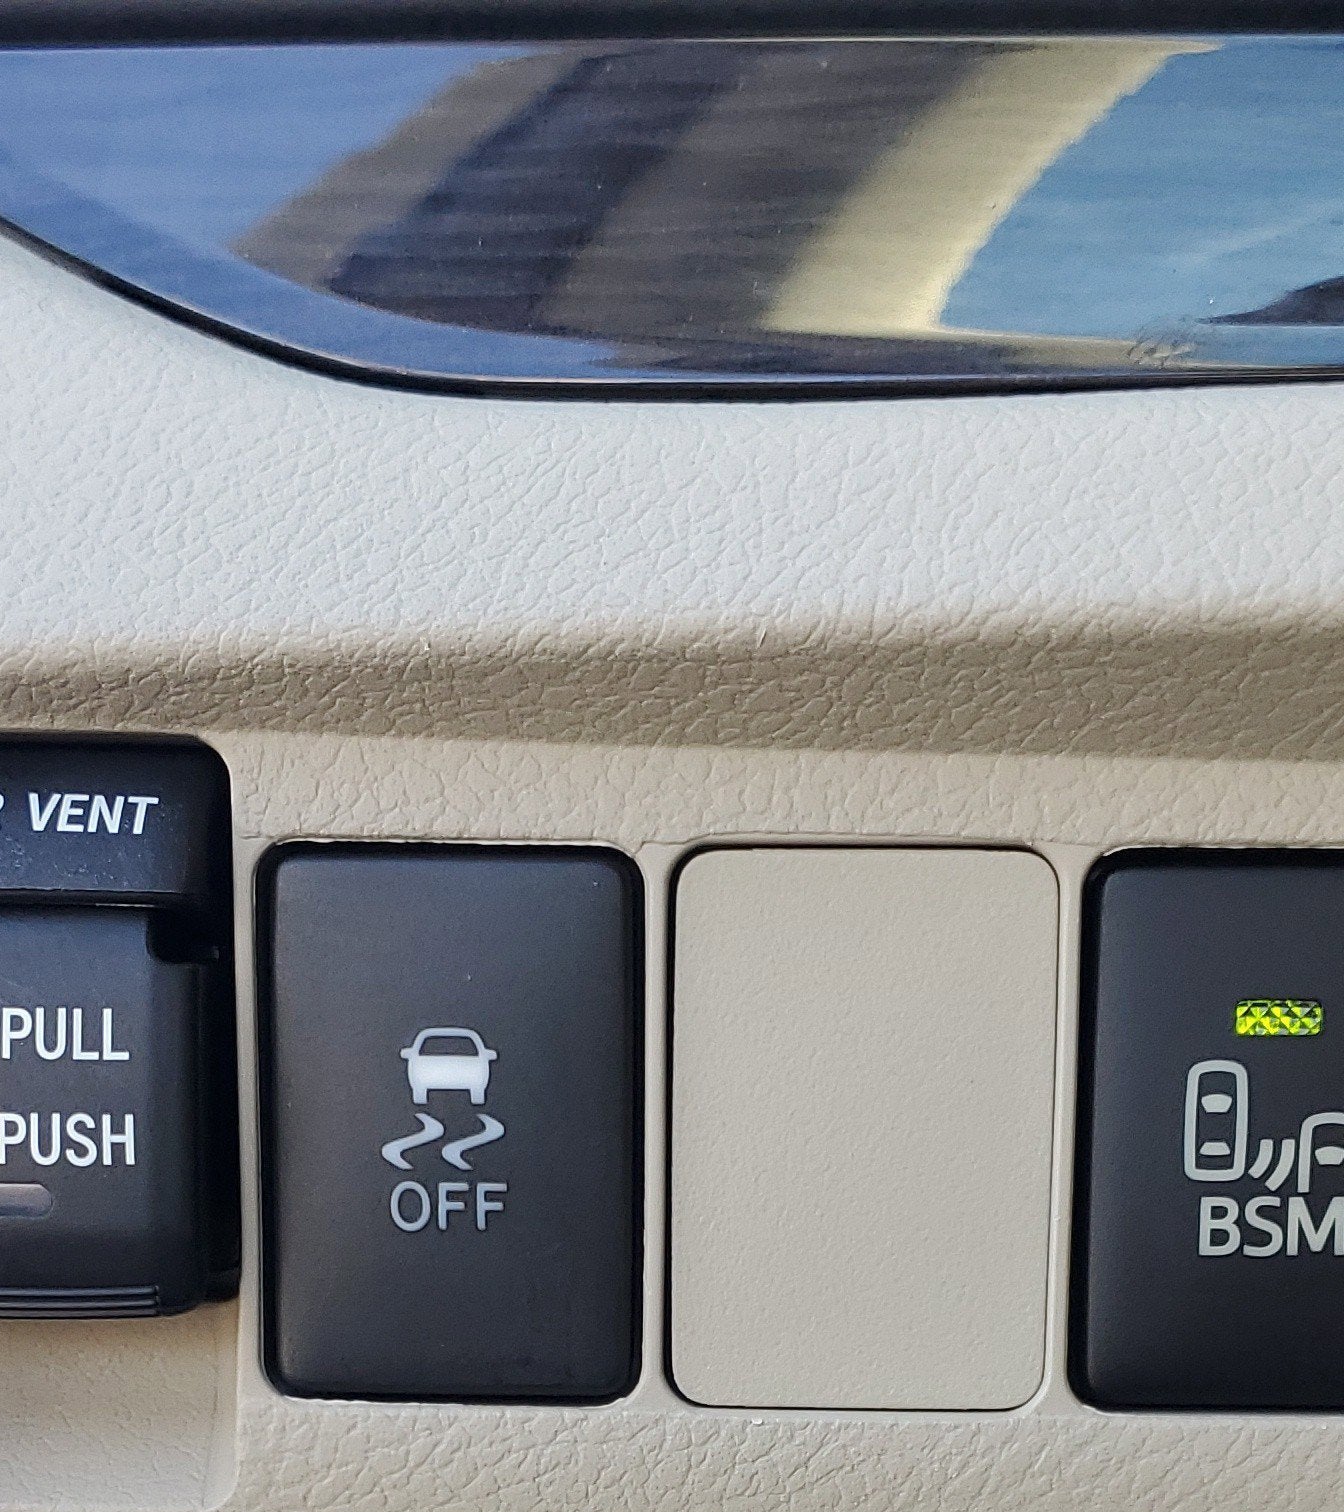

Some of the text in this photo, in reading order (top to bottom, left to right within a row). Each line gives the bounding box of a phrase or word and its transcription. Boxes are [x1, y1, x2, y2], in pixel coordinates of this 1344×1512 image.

[27, 791, 161, 836] VENT
[0, 1005, 131, 1062] PULL
[389, 1179, 509, 1233] OFF
